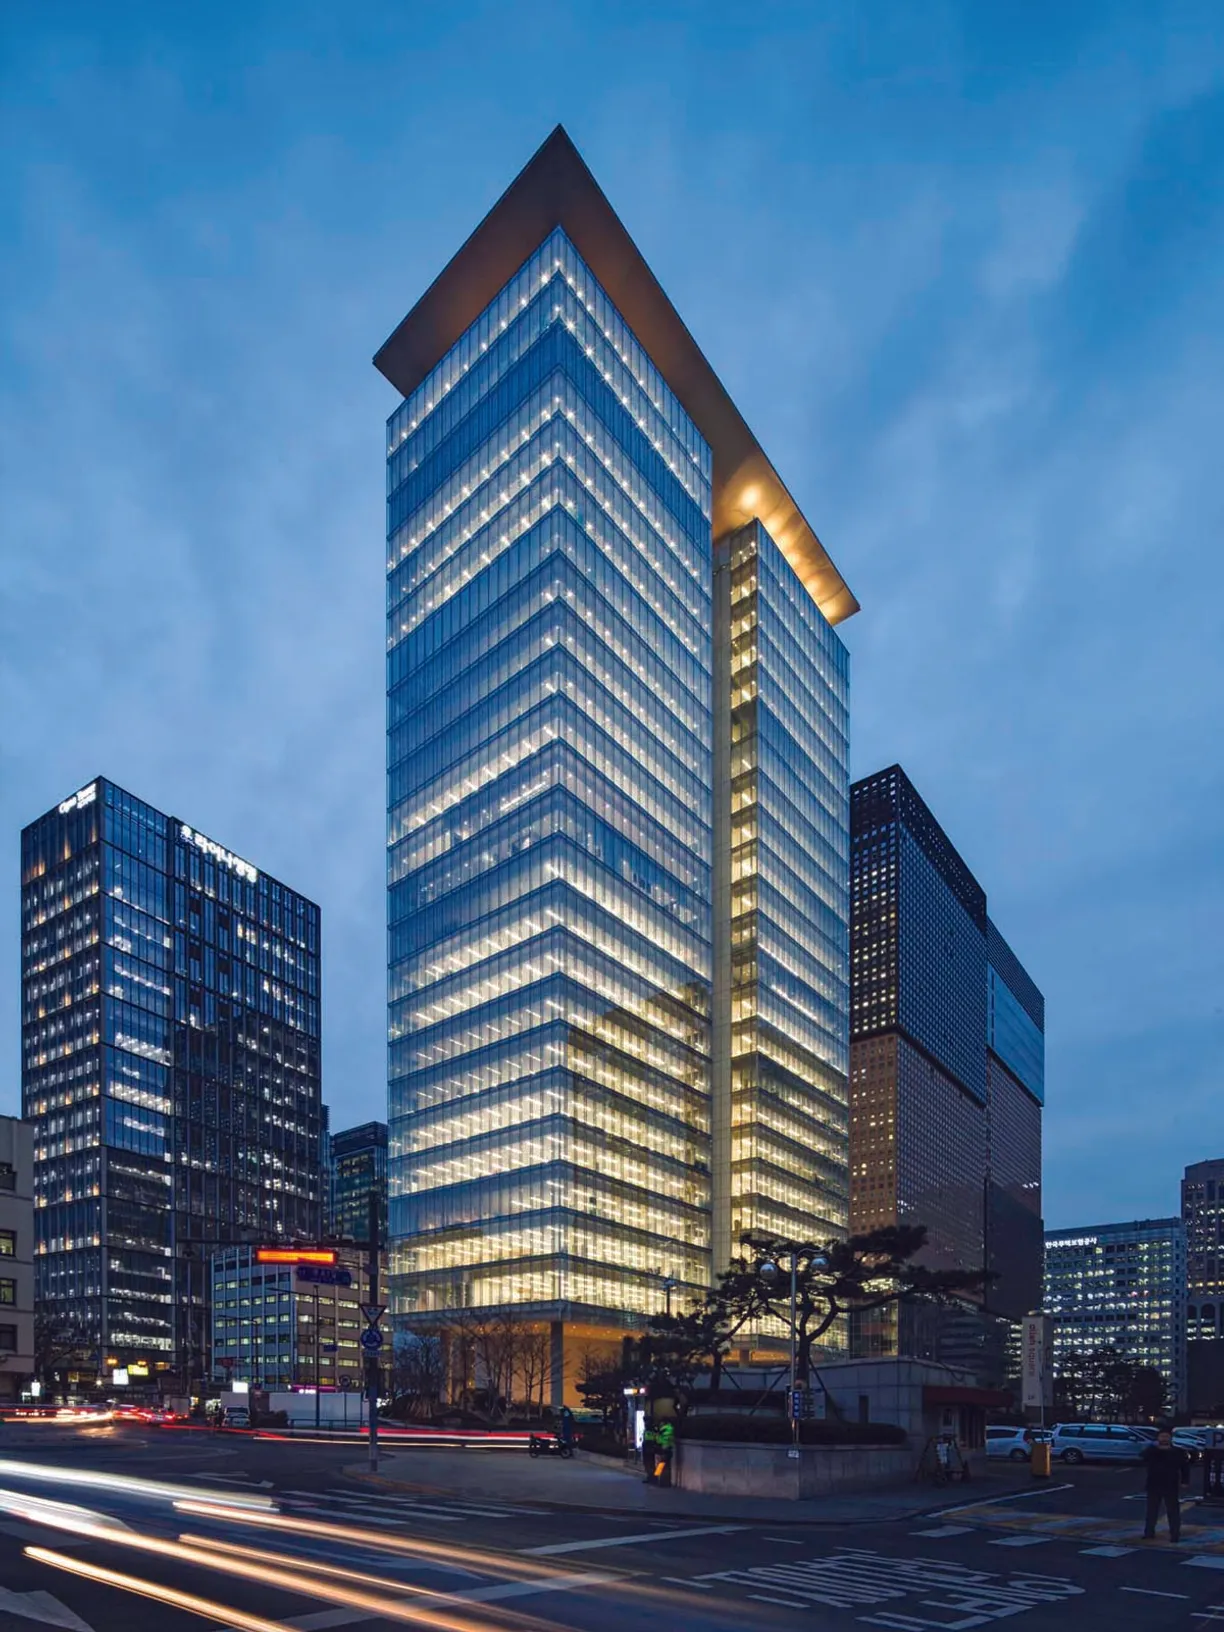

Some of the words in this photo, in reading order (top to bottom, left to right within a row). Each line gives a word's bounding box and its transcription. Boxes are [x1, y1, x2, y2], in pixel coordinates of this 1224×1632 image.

[194, 833, 257, 883] 라이나생명
[1045, 1237, 1097, 1249] 한국무역보험공사
[692, 1553, 1086, 1630] 진입차량
